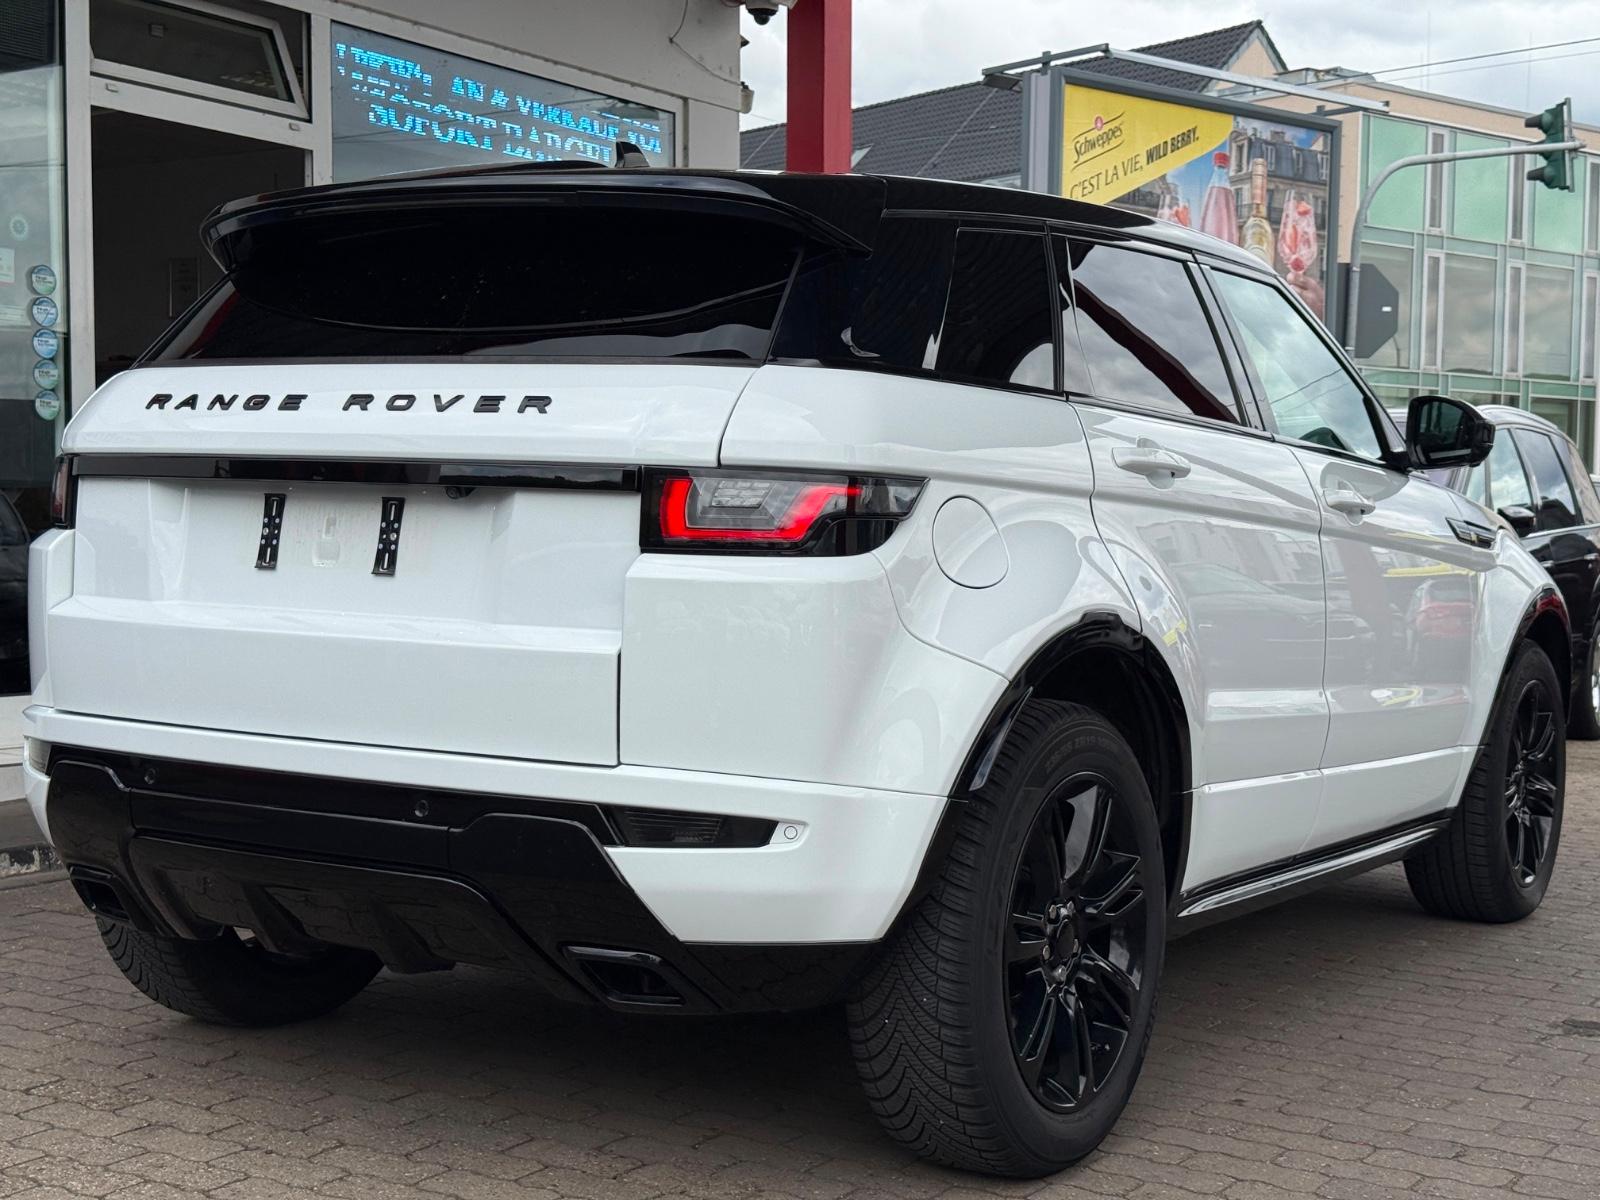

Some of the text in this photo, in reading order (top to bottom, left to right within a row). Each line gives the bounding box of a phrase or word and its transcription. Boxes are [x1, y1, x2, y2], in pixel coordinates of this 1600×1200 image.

[1070, 125, 1200, 199] C'EST LA VIE, WILD BERRY.
[1073, 121, 1124, 163] Schweppes
[145, 393, 553, 414] RANGE ROVER
